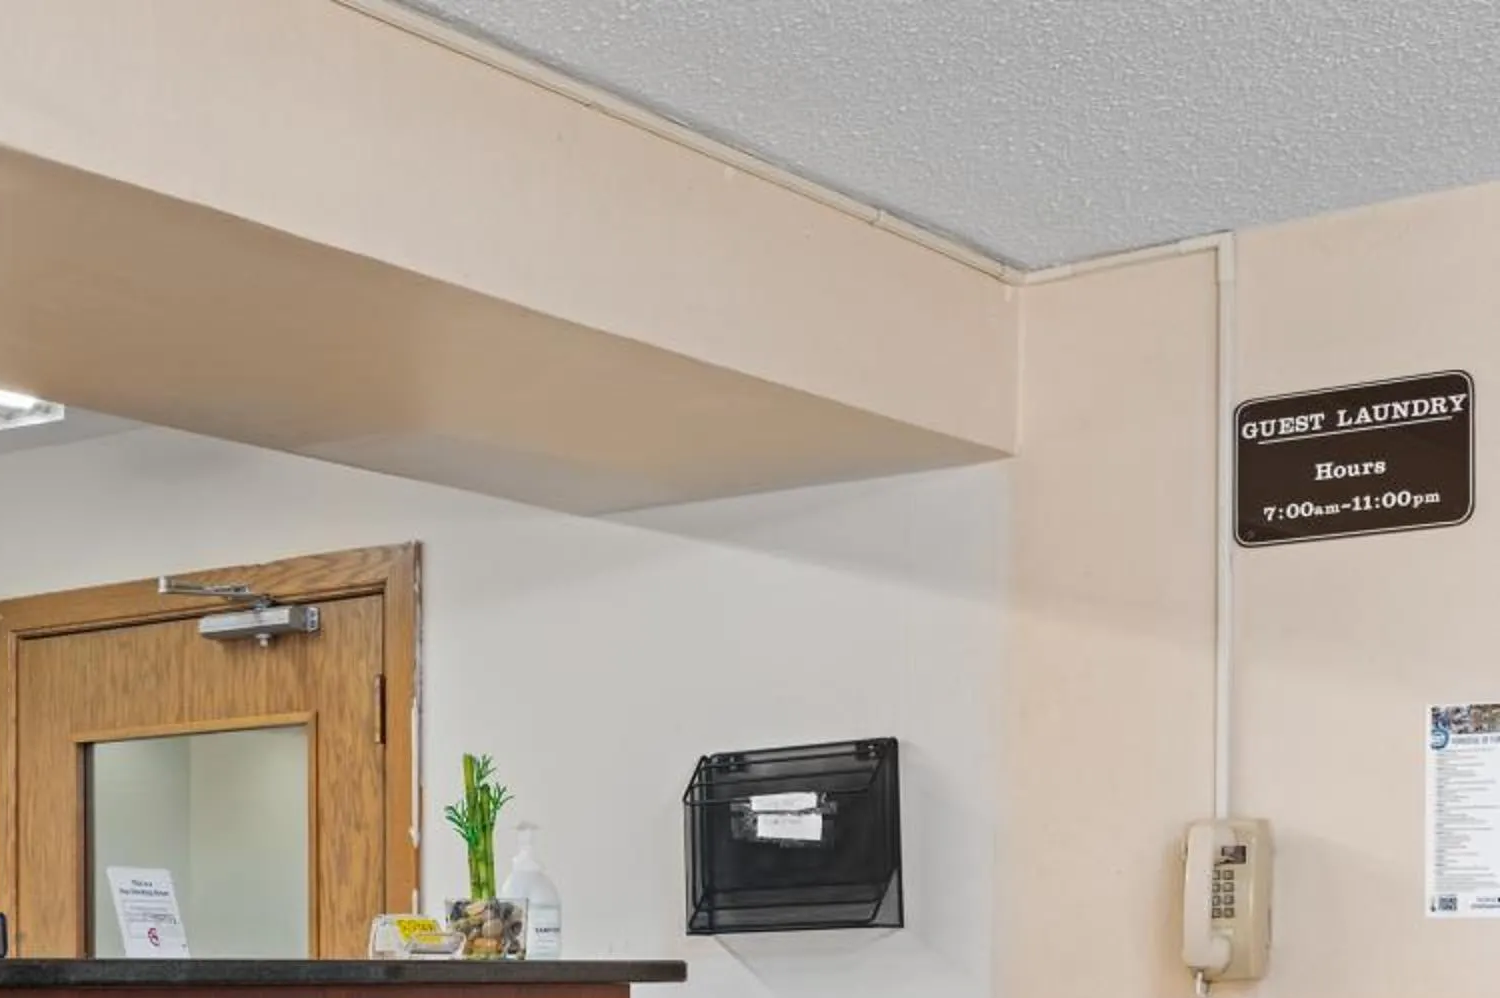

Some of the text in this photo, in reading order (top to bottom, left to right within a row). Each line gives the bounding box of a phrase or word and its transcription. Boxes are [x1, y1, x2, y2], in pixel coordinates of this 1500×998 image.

[1242, 393, 1468, 440] GUEST LAUNDRY
[1314, 460, 1388, 481] Hours
